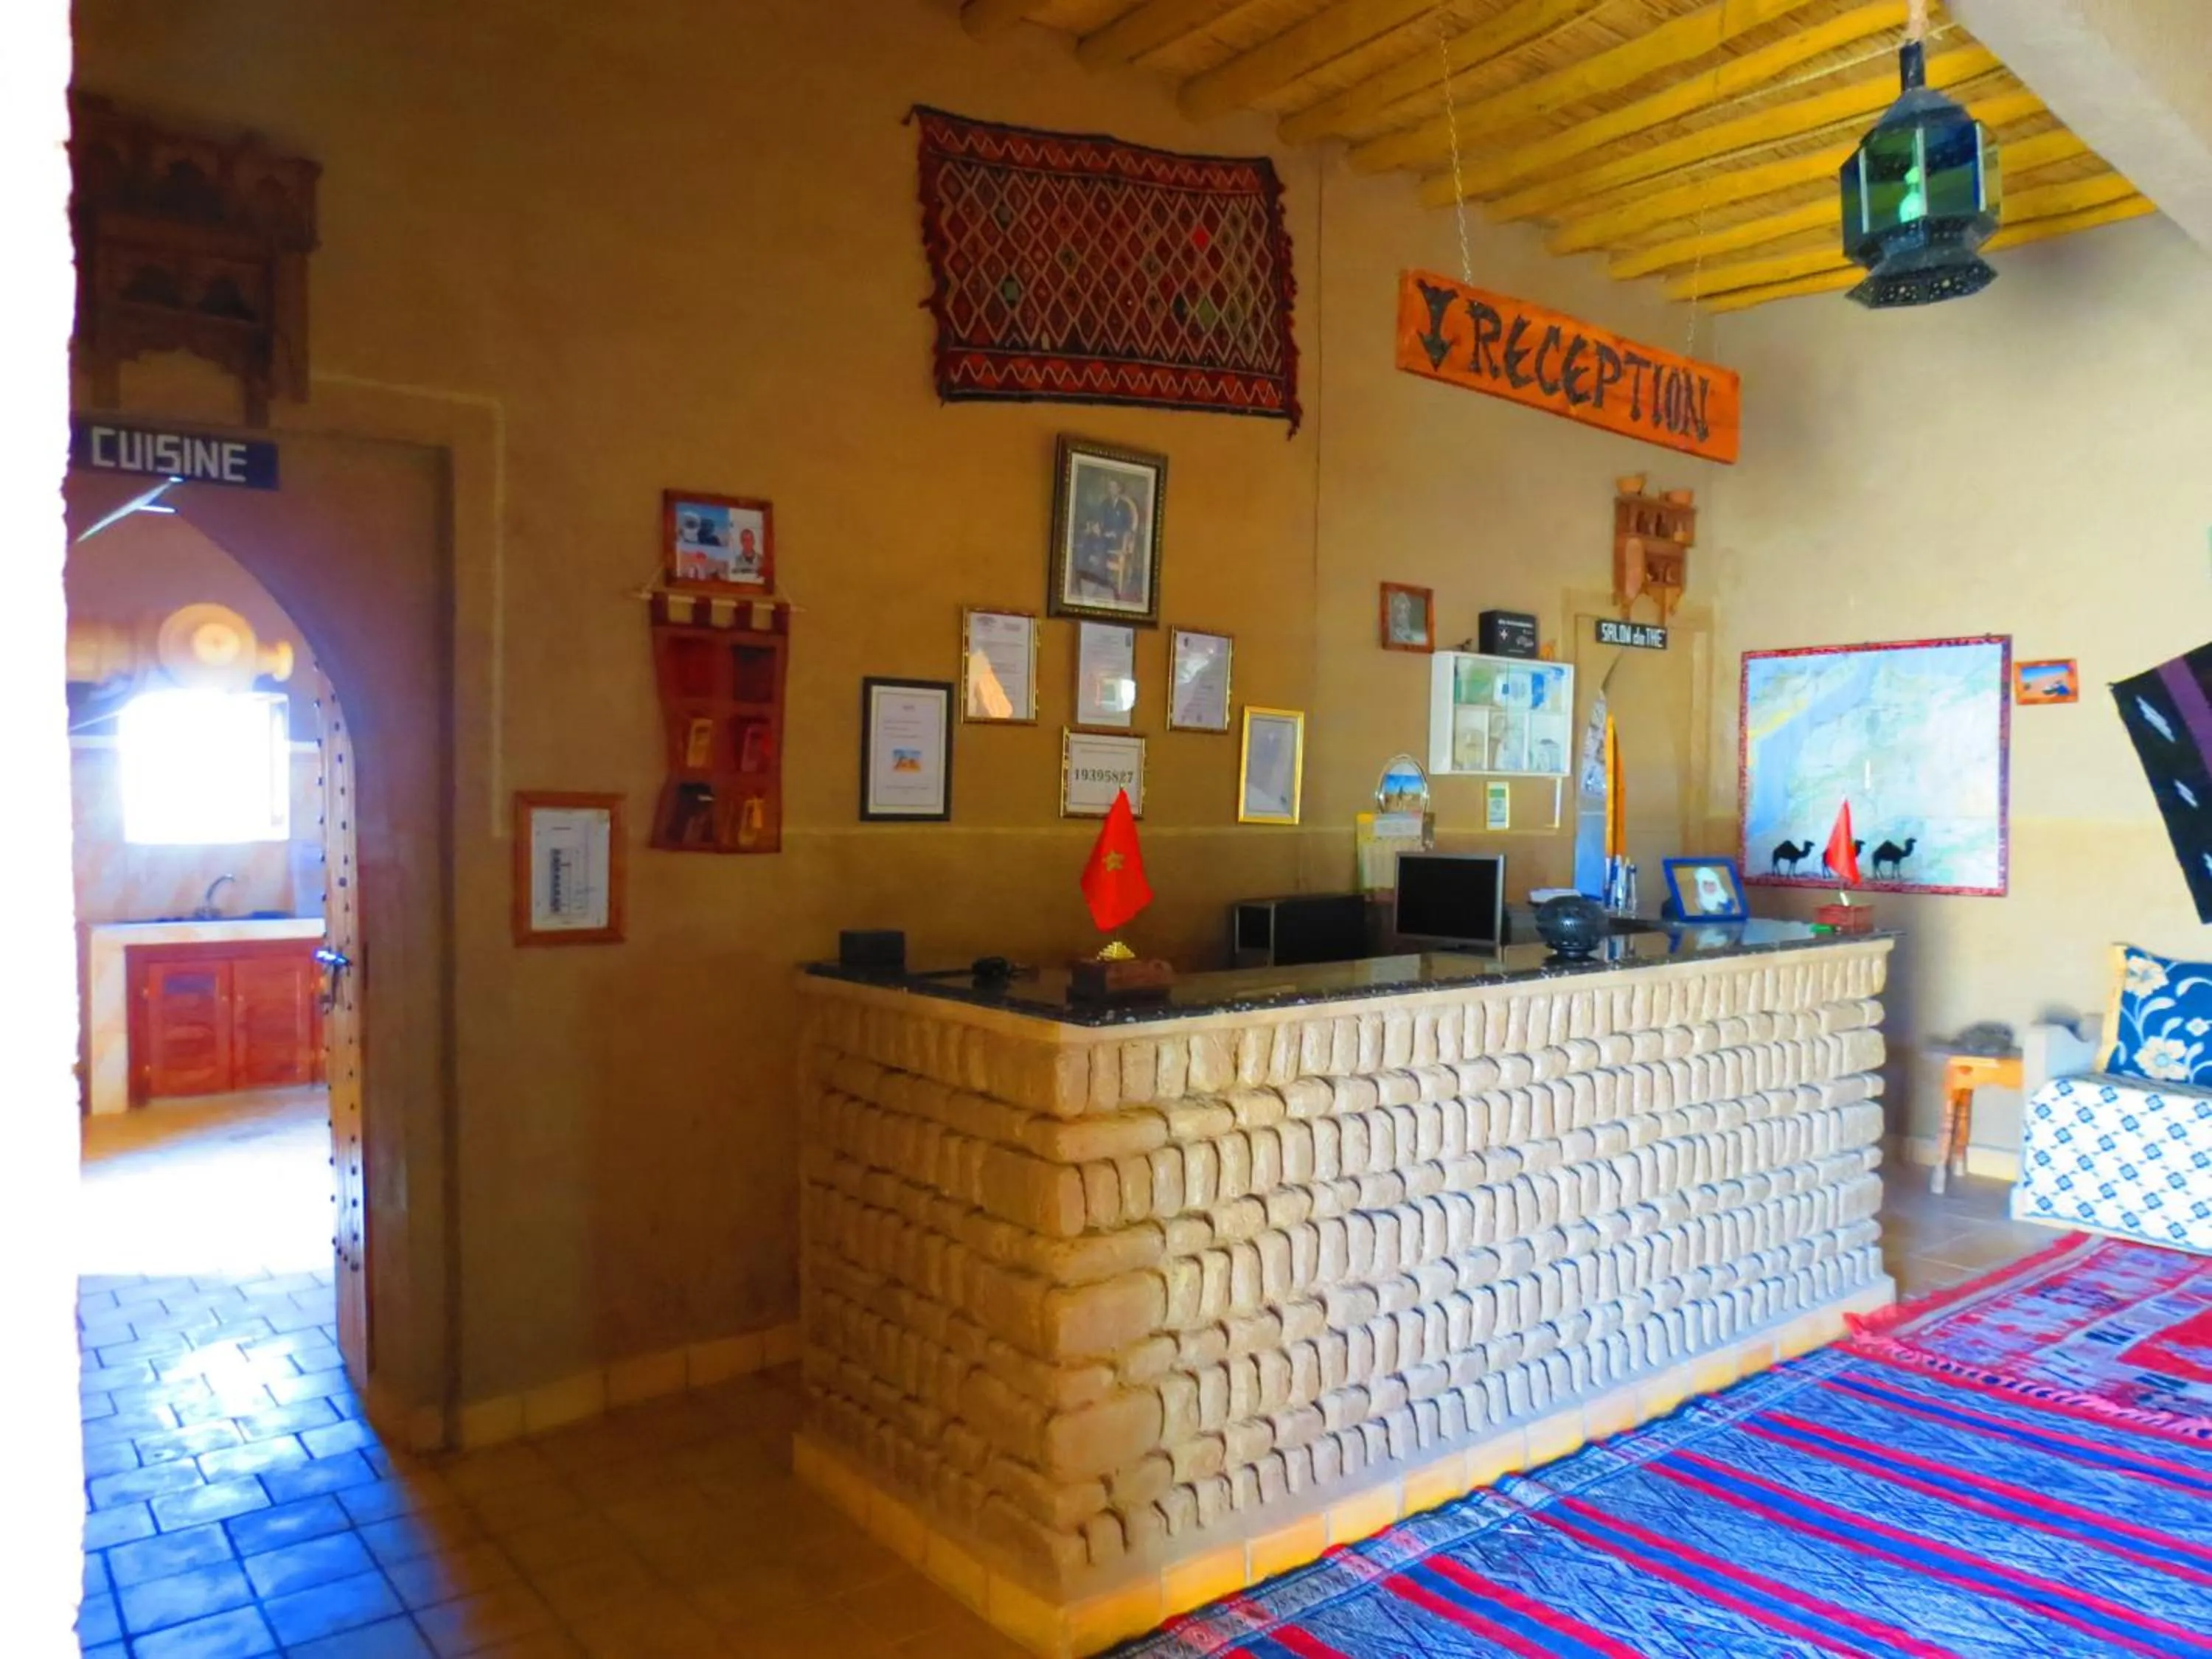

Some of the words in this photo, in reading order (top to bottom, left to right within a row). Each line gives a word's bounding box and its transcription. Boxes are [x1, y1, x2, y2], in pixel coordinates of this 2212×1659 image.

[1466, 298, 1709, 442] RECEPTION
[91, 425, 248, 482] CUISINE
[1601, 623, 1631, 644] SALON
